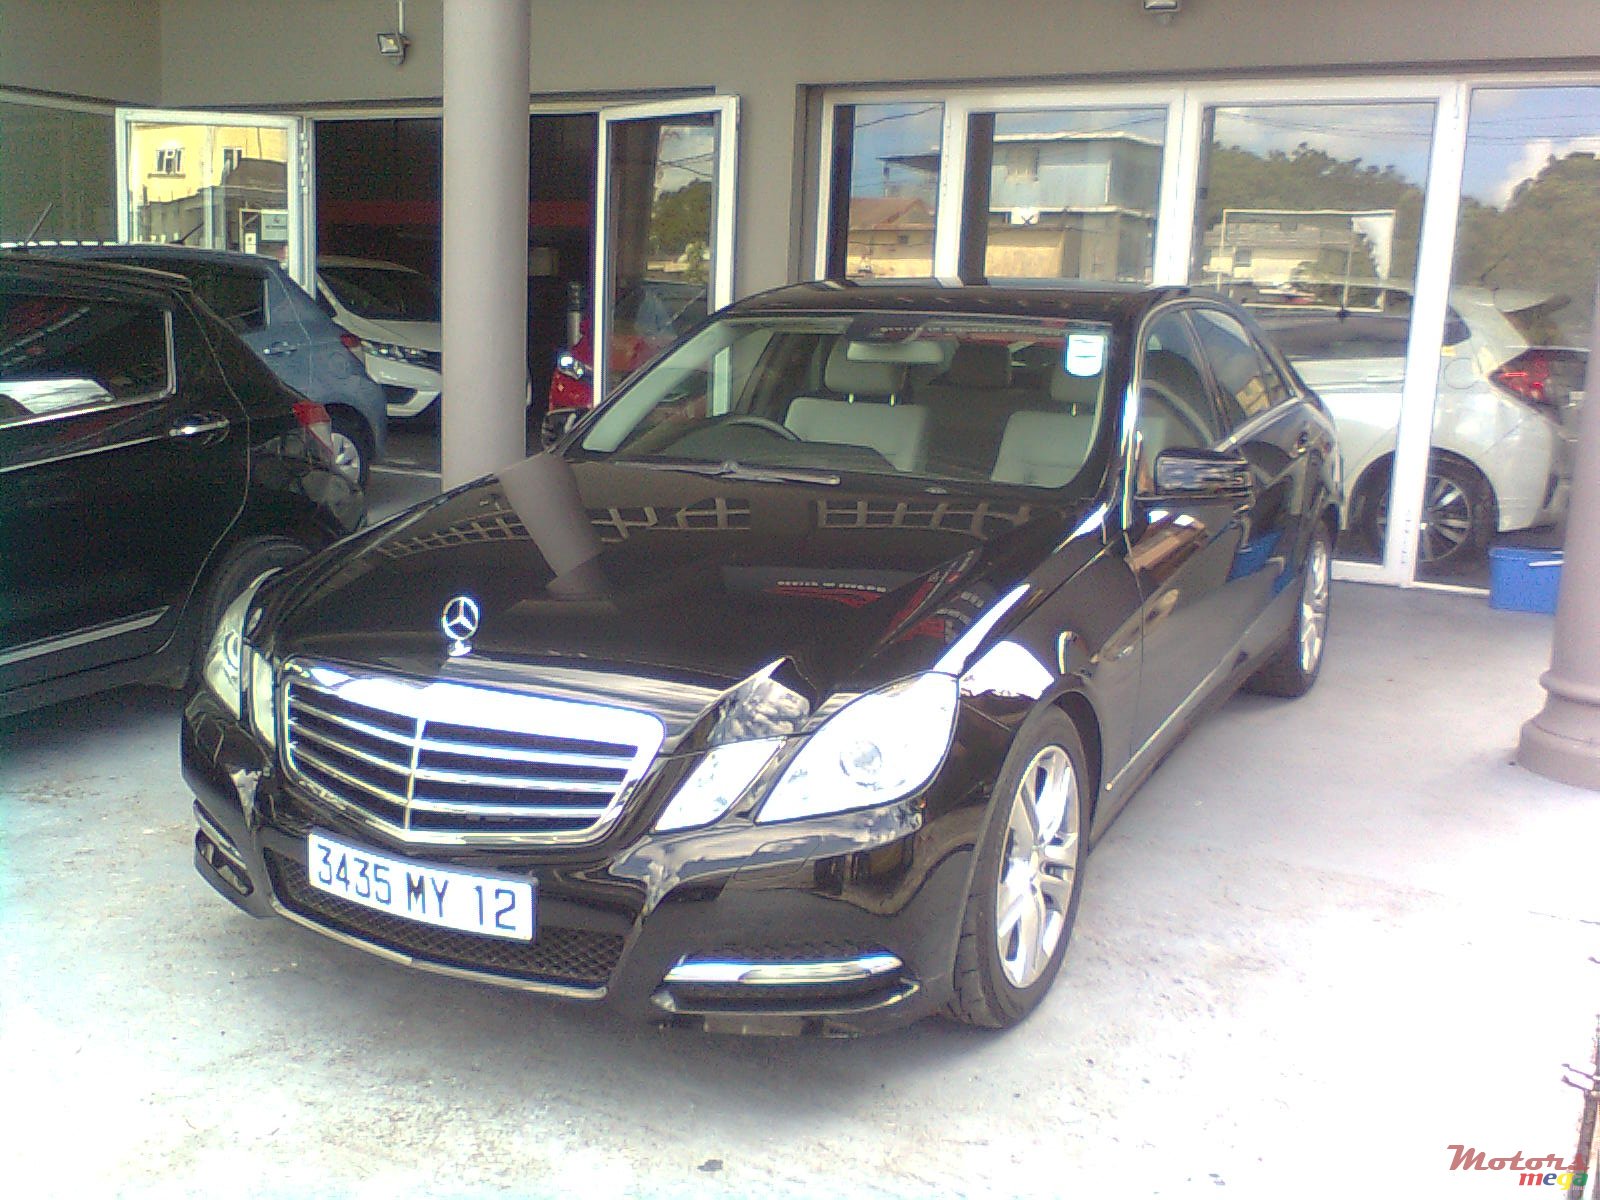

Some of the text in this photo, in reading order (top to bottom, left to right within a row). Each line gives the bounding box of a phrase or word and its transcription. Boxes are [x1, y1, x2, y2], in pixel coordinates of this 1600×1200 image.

[317, 843, 517, 931] 3435 MY 12
